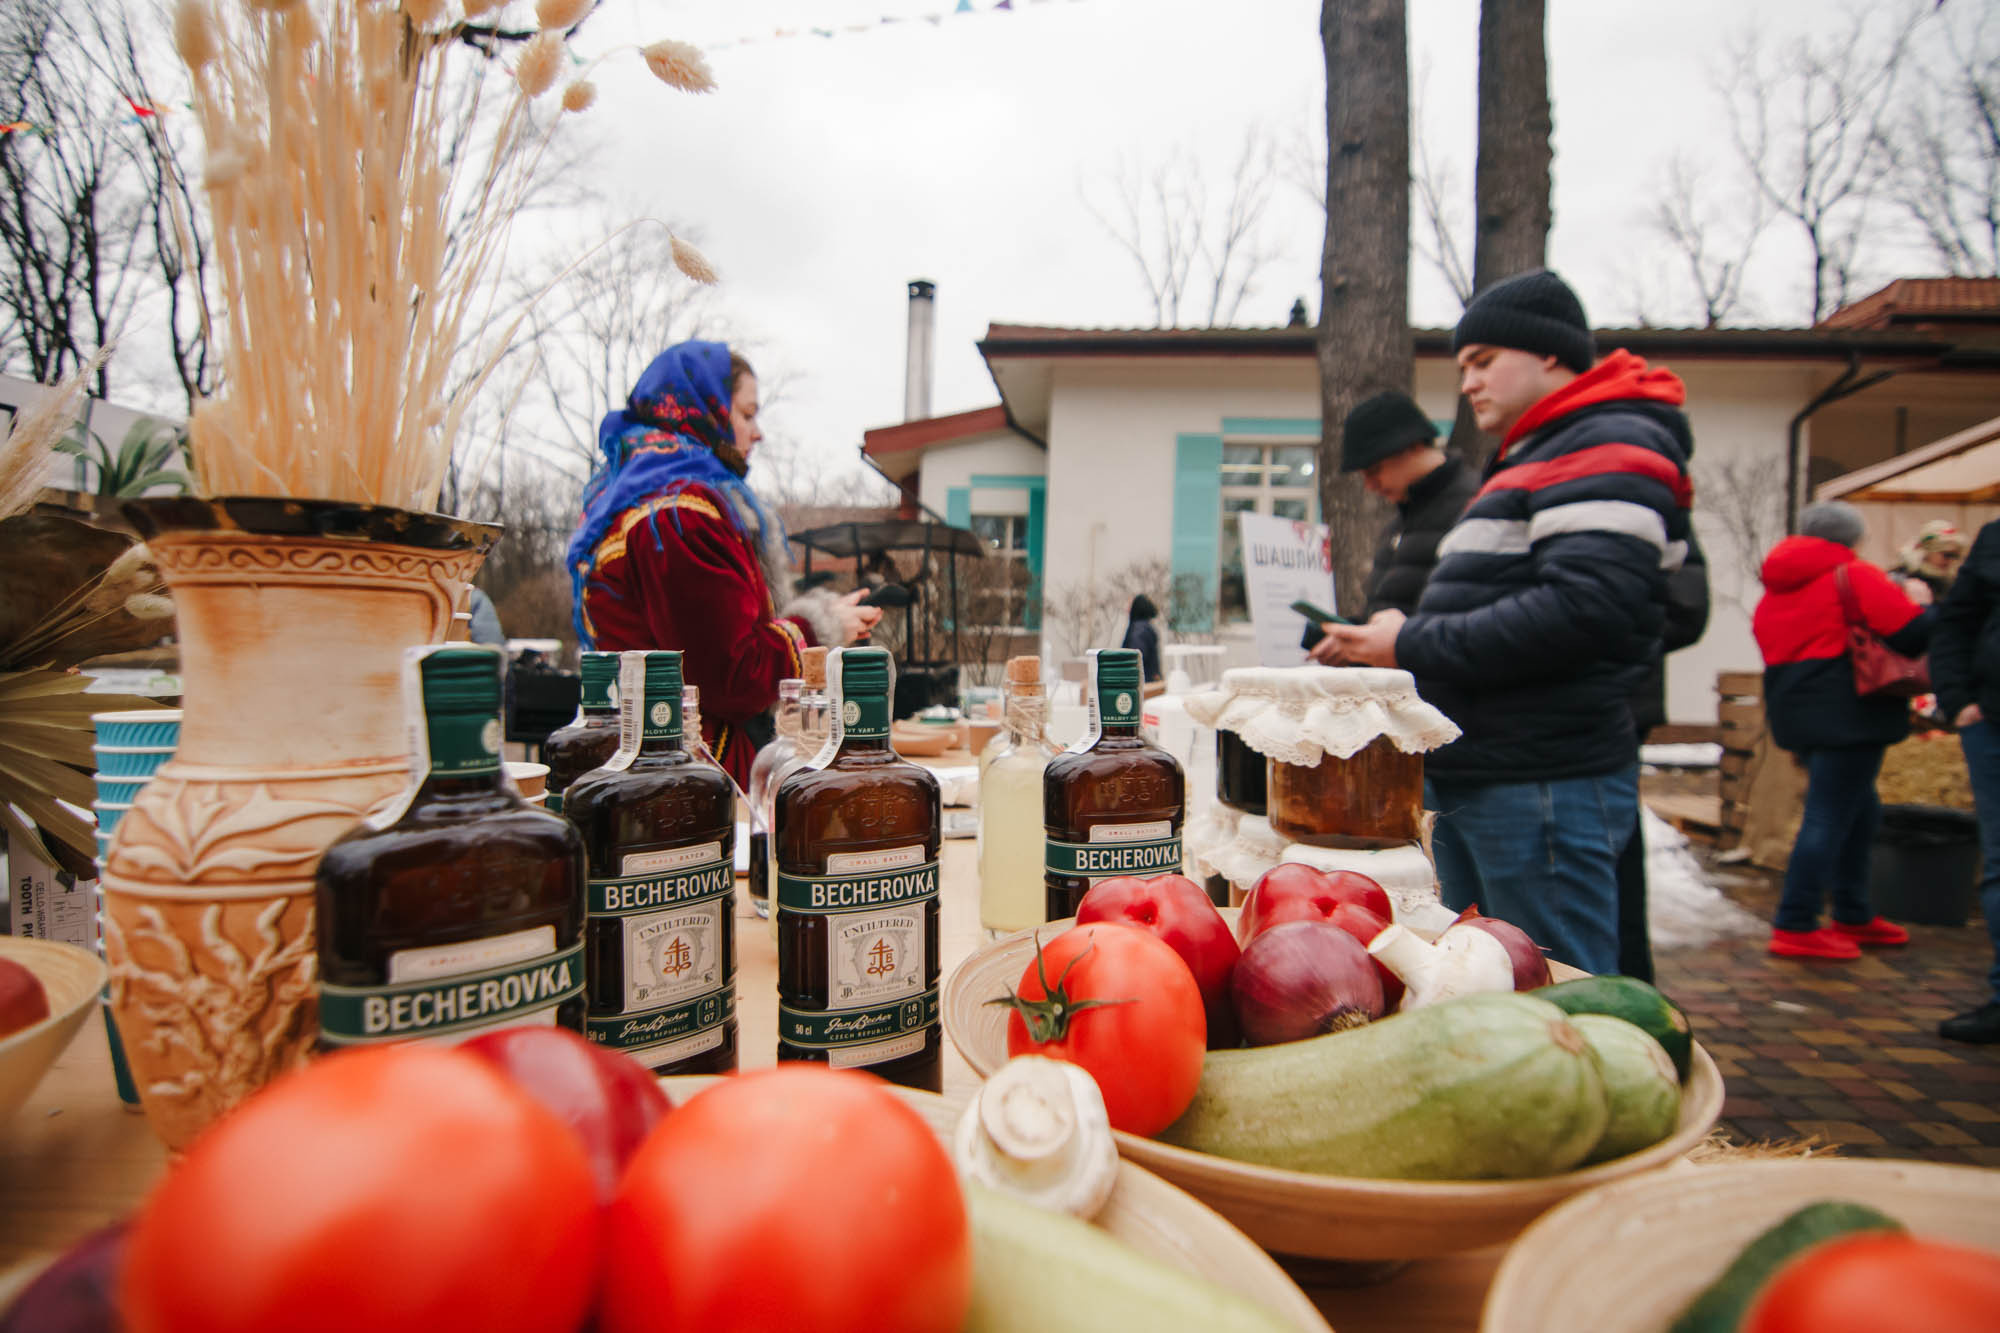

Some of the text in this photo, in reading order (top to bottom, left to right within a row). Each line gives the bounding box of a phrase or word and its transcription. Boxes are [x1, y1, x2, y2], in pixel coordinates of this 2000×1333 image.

[1075, 844, 1180, 870] BECHEROVKA
[21, 876, 34, 915] TOOTH
[605, 867, 731, 910] BECHEROVKA
[811, 869, 935, 907] BECHEROVKA
[639, 915, 711, 940] UNFILTERED
[843, 918, 914, 938] UNFILTERED
[363, 960, 573, 1034] BECHEROVKA
[704, 999, 714, 1010] 18
[704, 1012, 715, 1023] 07
[907, 1003, 918, 1013] 18
[795, 1024, 813, 1036] 50 cl
[906, 1015, 918, 1026] 07
[829, 1026, 892, 1041] CZECH REPUBLIC
